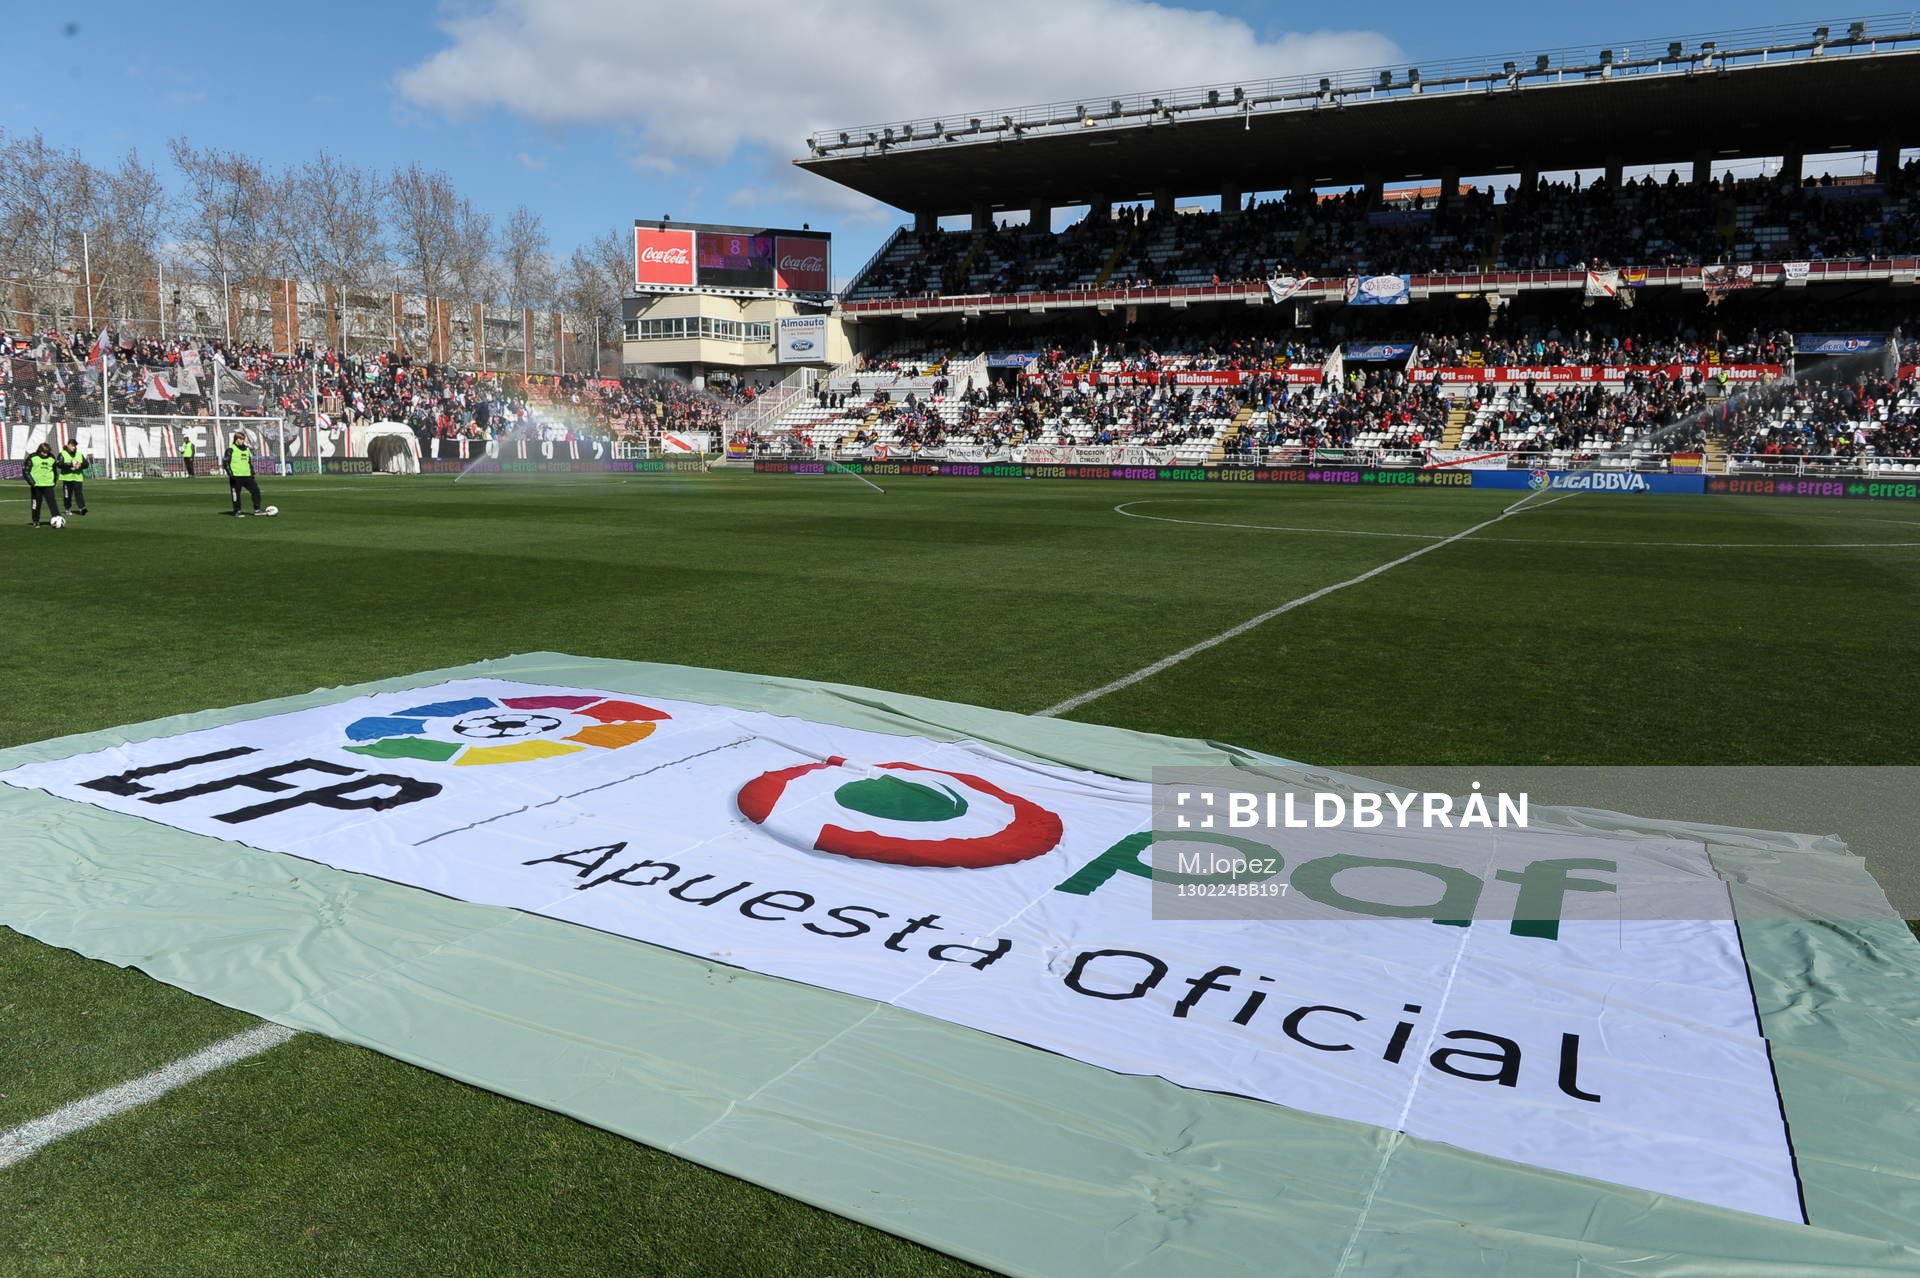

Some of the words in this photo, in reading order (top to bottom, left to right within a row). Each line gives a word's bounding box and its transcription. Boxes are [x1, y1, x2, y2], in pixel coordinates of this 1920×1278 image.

[641, 247, 688, 265] Coca-Cola
[780, 256, 824, 272] Coca-Cola
[781, 318, 824, 327] Almoauto
[1177, 373, 1213, 384] Mahou
[341, 459, 373, 474] errea
[512, 461, 538, 472] errea
[643, 460, 665, 471] errea
[764, 462, 789, 473] errea
[800, 462, 825, 473] errea
[836, 462, 862, 474] errea
[873, 463, 901, 475] errea
[952, 464, 980, 477] errea
[994, 464, 1023, 477] errea
[1036, 465, 1066, 478] errea
[1080, 466, 1110, 478] errea
[1125, 467, 1157, 480] errea
[1172, 468, 1205, 480] errea
[1221, 469, 1256, 481] errea
[1271, 469, 1306, 482] errea
[1322, 470, 1359, 483] errea
[1377, 471, 1416, 484] errea
[1433, 471, 1472, 485] errea
[1551, 475, 1591, 489] LIGA
[1592, 472, 1647, 490] BBVA
[1728, 478, 1775, 494] errea
[1797, 480, 1844, 496] errea
[1868, 481, 1917, 498] errea
[75, 745, 443, 824] LFP
[1053, 829, 1618, 941] Paf
[522, 841, 1013, 971] Apuesta
[1064, 949, 1601, 1103] Oficial
